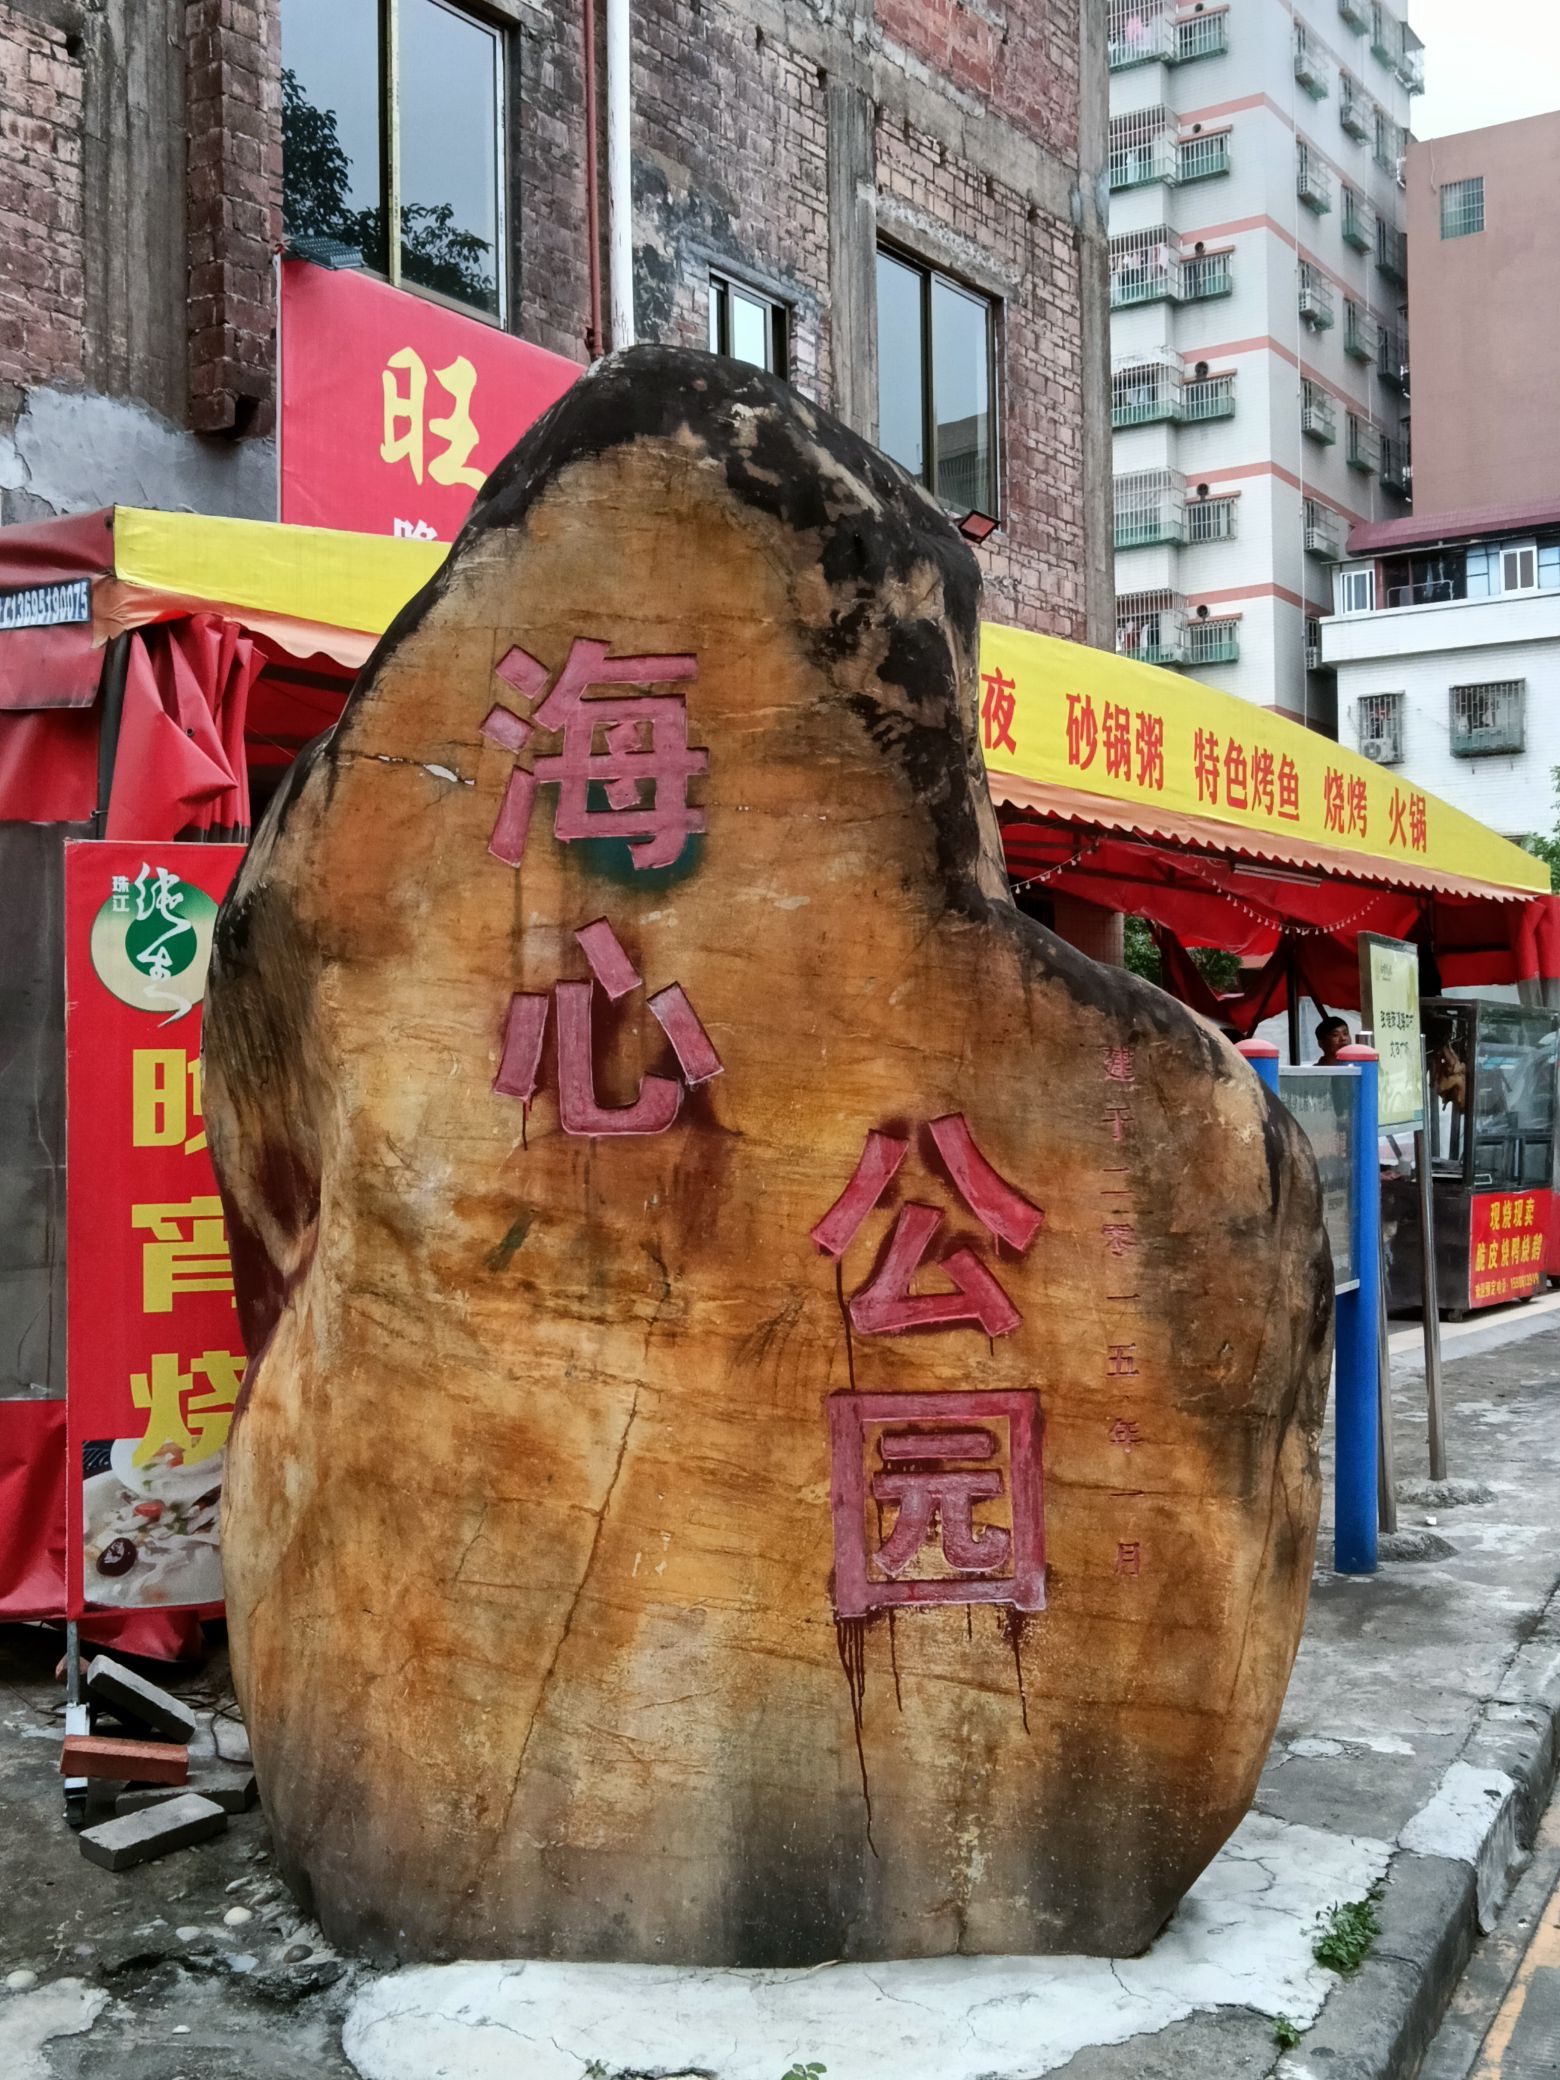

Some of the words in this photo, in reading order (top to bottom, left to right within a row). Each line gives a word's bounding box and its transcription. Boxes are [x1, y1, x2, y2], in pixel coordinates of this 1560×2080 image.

[379, 346, 489, 491] 旺
[981, 666, 1017, 755] 夜
[1066, 692, 1164, 791] 砂锅粥
[1194, 727, 1300, 822] 特色烤鱼
[1324, 766, 1367, 838] 烧烤
[1388, 786, 1427, 853] 火锅
[479, 637, 724, 1137] 海心
[810, 1111, 1047, 1618] 公园
